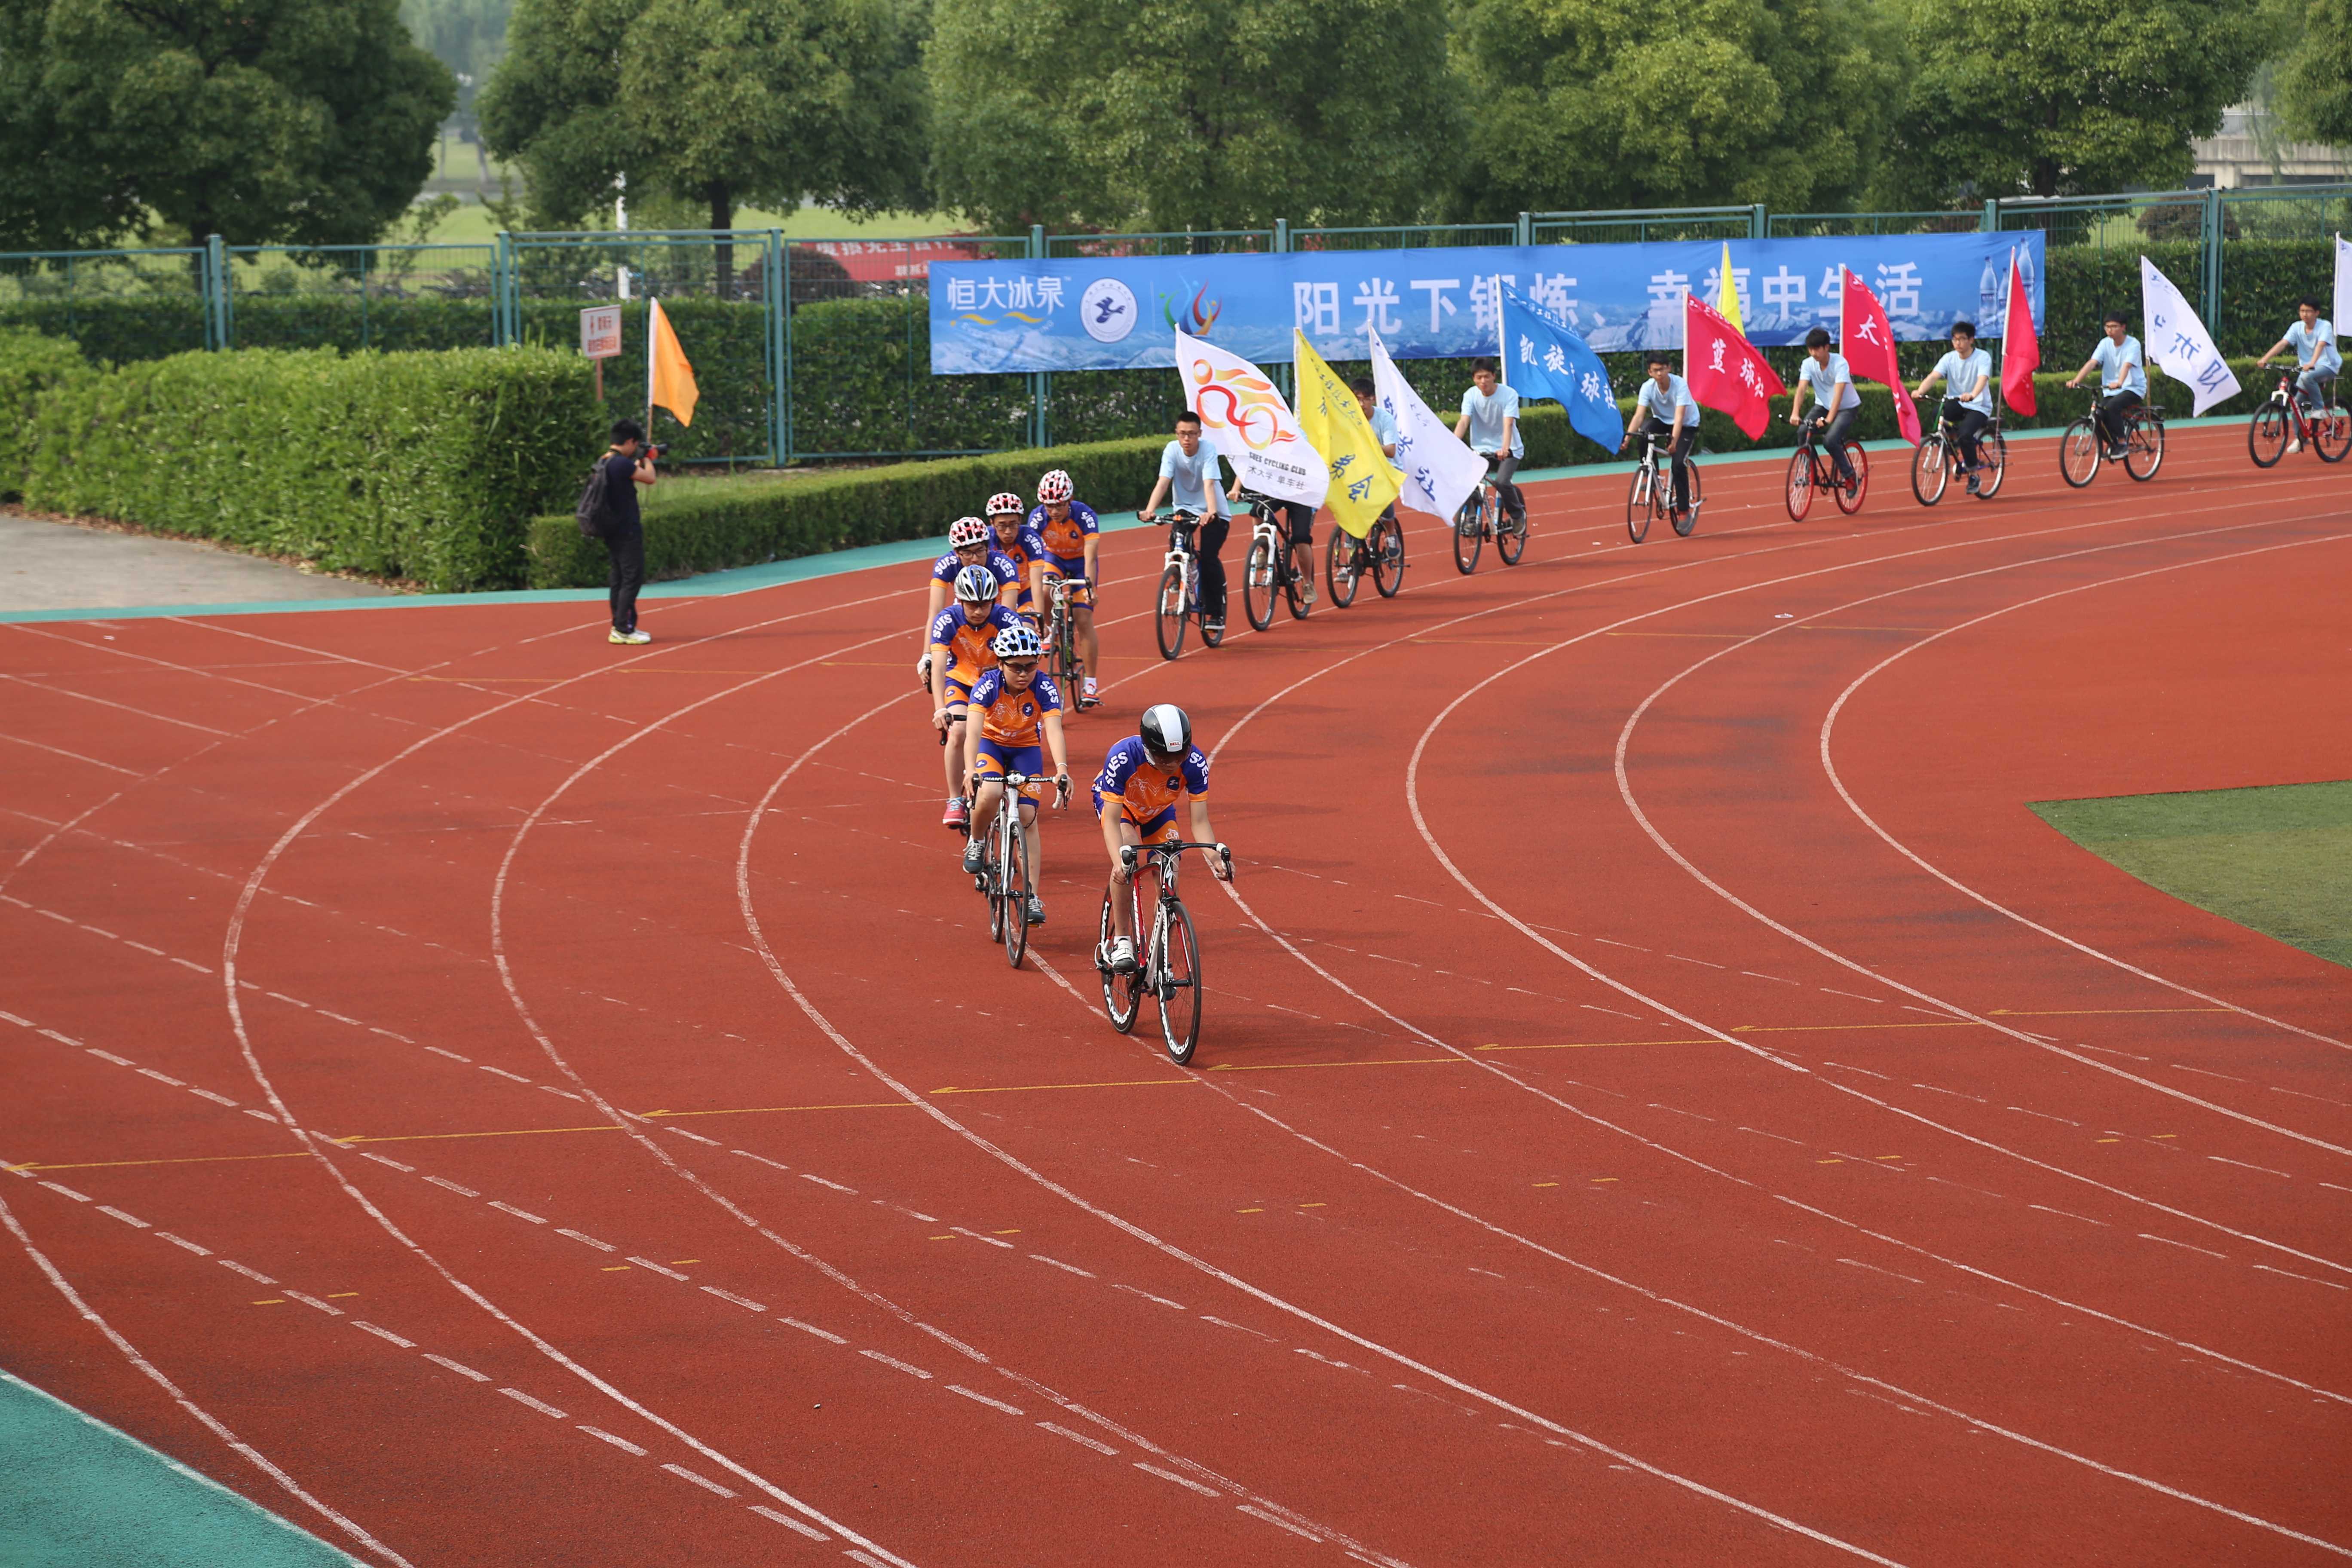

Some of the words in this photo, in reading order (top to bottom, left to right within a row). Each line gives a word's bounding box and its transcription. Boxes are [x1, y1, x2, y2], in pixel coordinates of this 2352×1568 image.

[947, 276, 1065, 315] 恒大冰泉
[1029, 512, 1043, 530] SS
[1105, 752, 1128, 787] SUES
